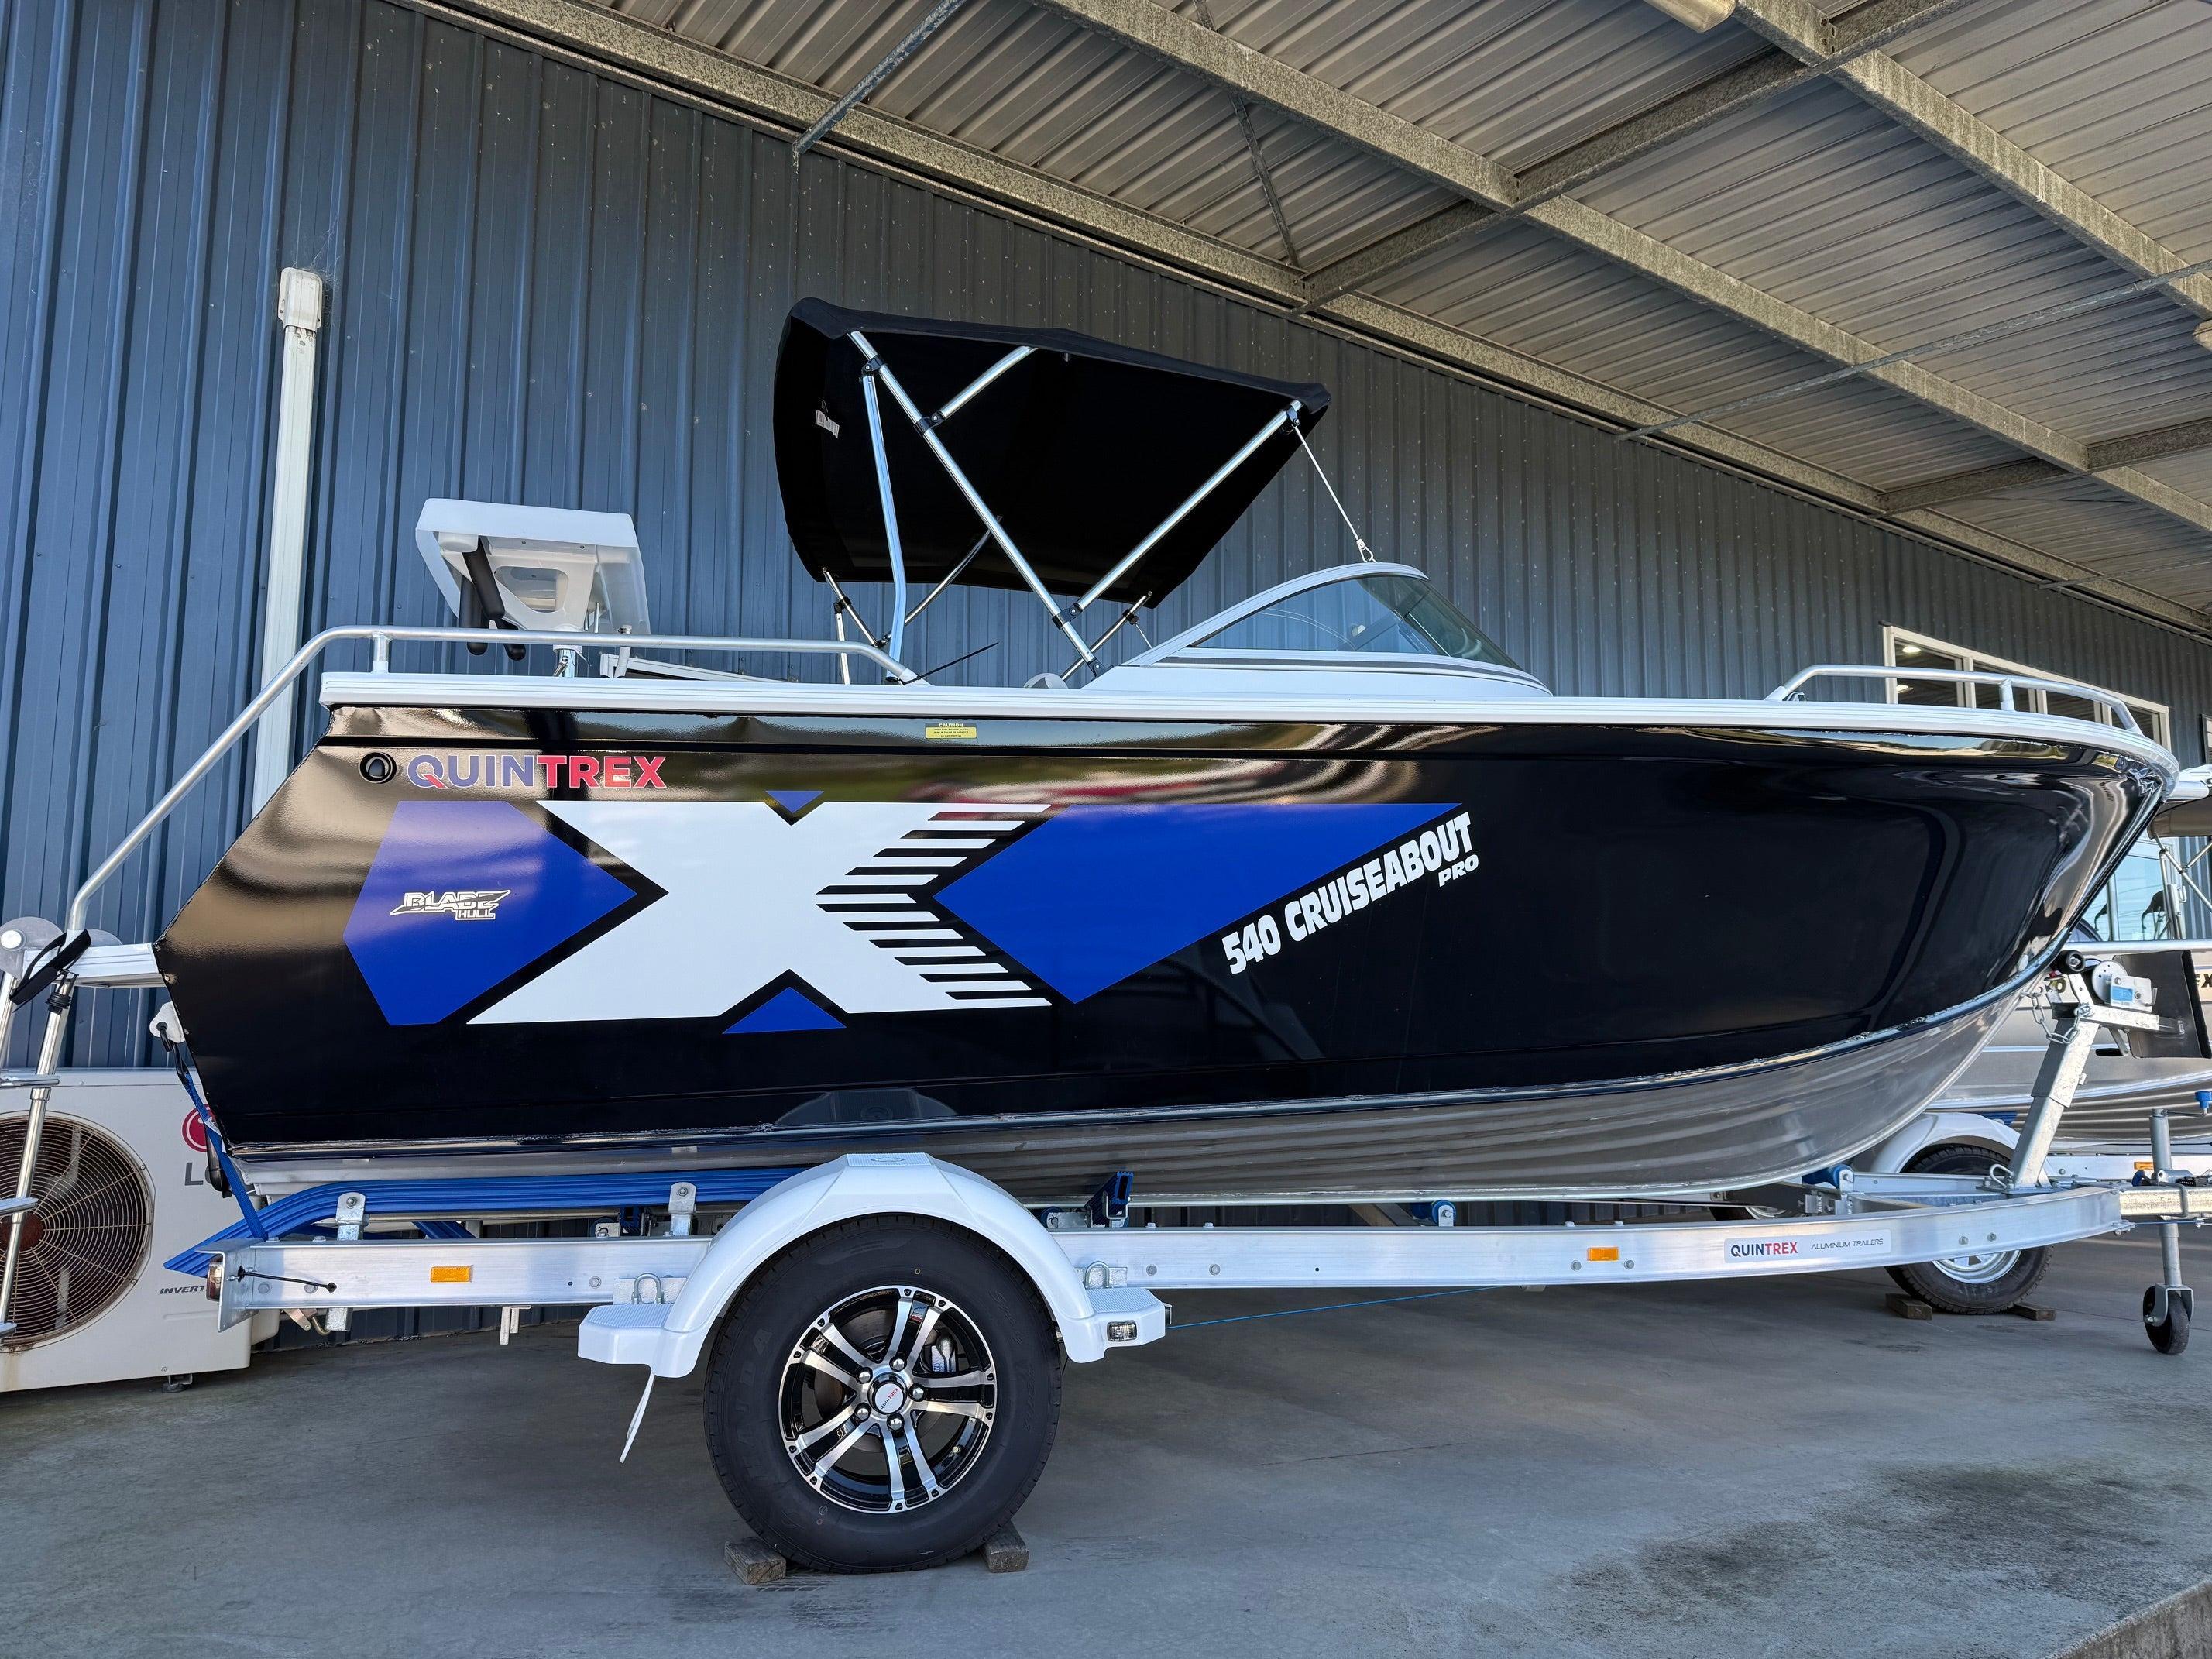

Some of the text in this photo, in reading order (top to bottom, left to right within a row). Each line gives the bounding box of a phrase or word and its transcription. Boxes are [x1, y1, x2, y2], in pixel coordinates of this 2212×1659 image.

[407, 754, 667, 789] QUINTREX
[1438, 854, 1479, 887] PRO
[399, 890, 510, 912] BLADE
[1221, 812, 1473, 974] 540 CRUISEABOUT
[456, 909, 496, 920] HULL
[185, 1163, 212, 1185] L
[1730, 1238, 1884, 1257] QUINTREX ALUMINIUM TRAILERS
[160, 1286, 208, 1294] INVERT
[880, 1388, 899, 1410] QUINTREX
